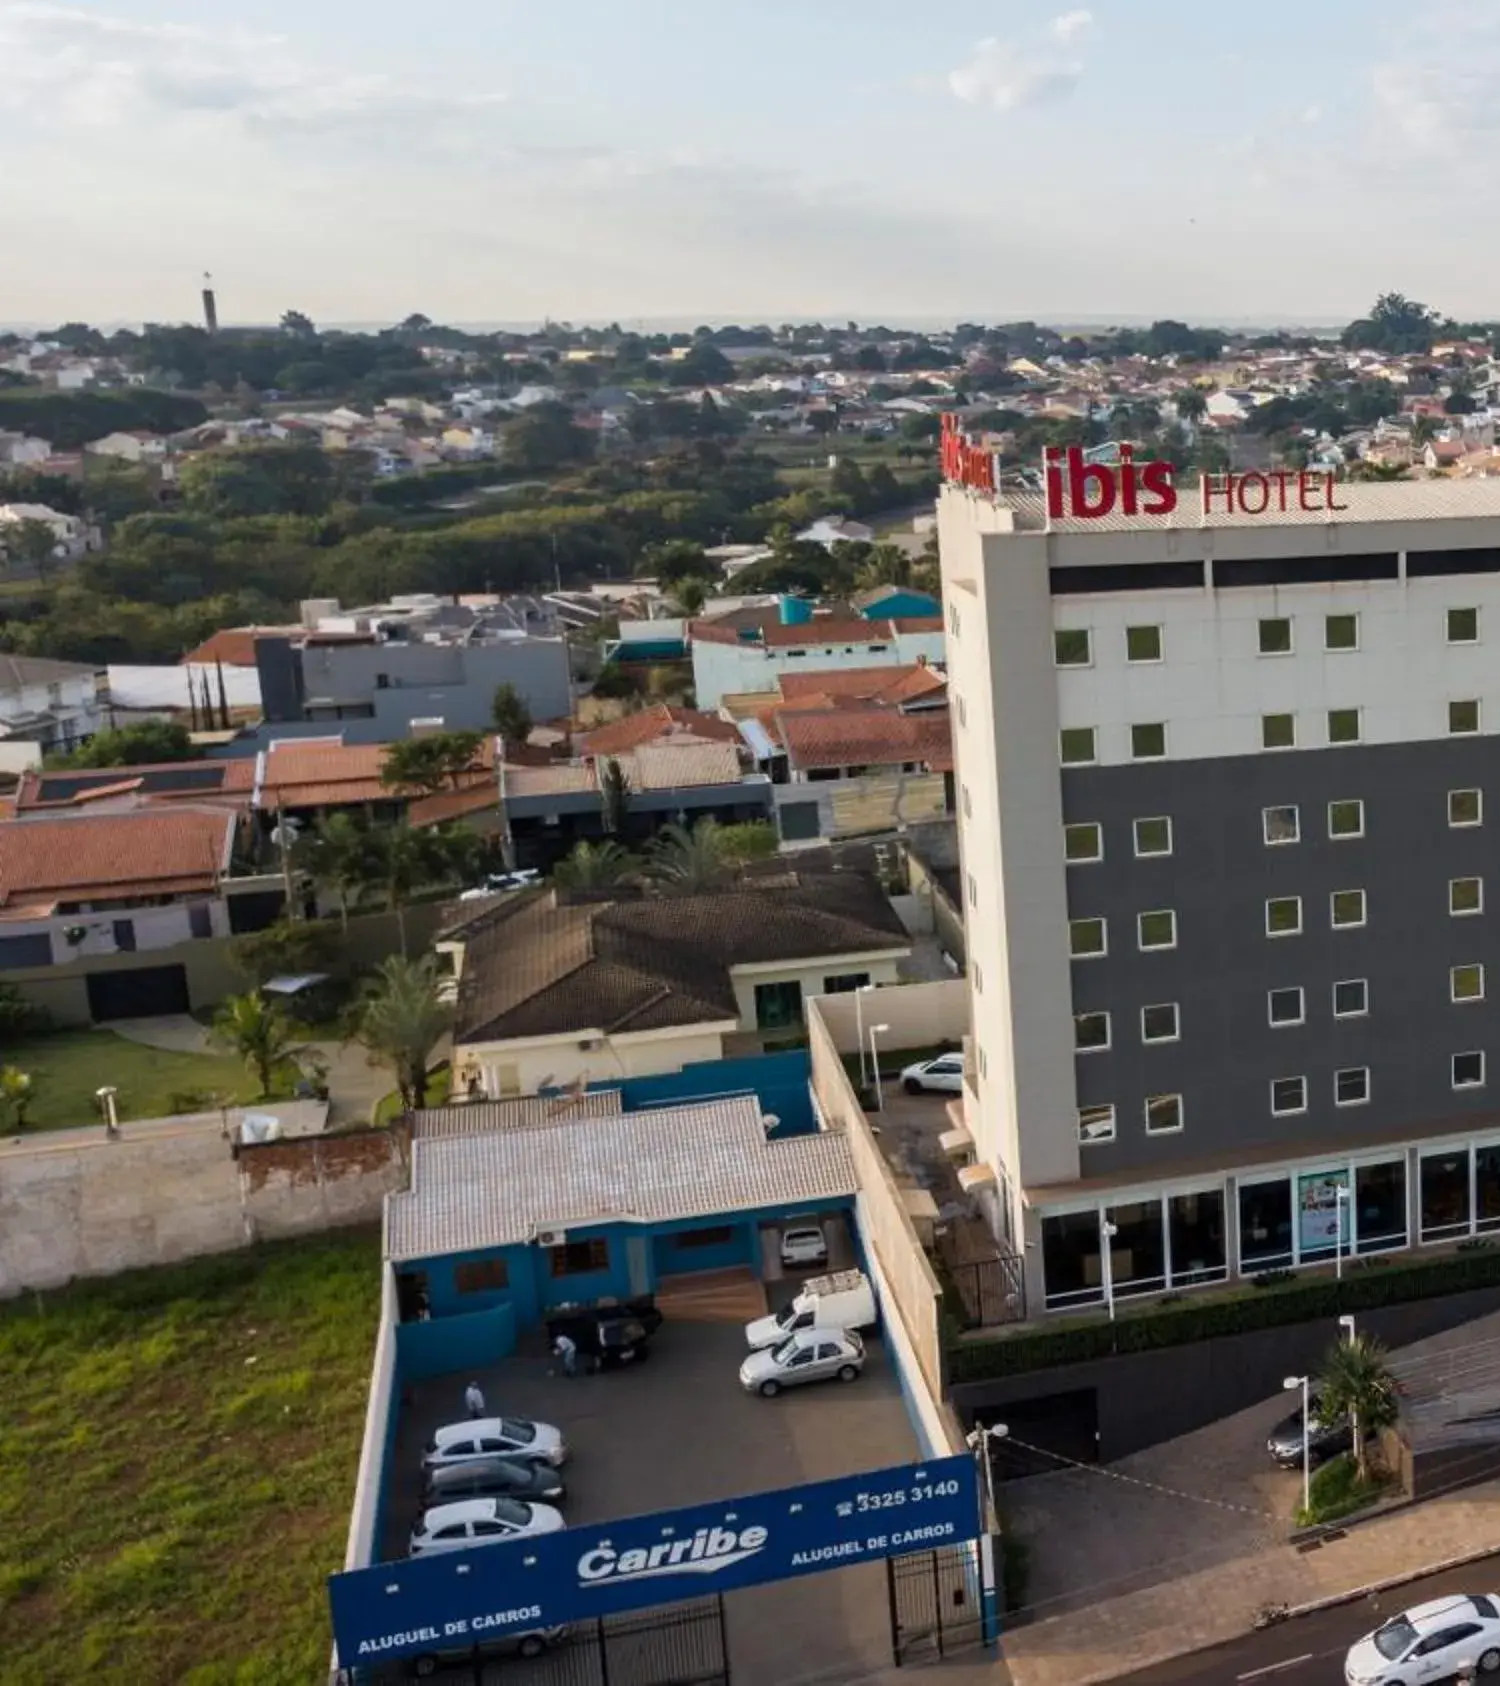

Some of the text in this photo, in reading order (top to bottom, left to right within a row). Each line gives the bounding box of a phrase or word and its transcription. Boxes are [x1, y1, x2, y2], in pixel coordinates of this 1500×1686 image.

[1046, 444, 1177, 519] ibis
[1204, 471, 1348, 514] HOTEL
[911, 1480, 959, 1502] 3140
[577, 1525, 768, 1579] Carribe
[791, 1522, 954, 1566] ALUGUEL DE CARROS
[358, 1604, 541, 1654] ALUGUEL DE CARROS
